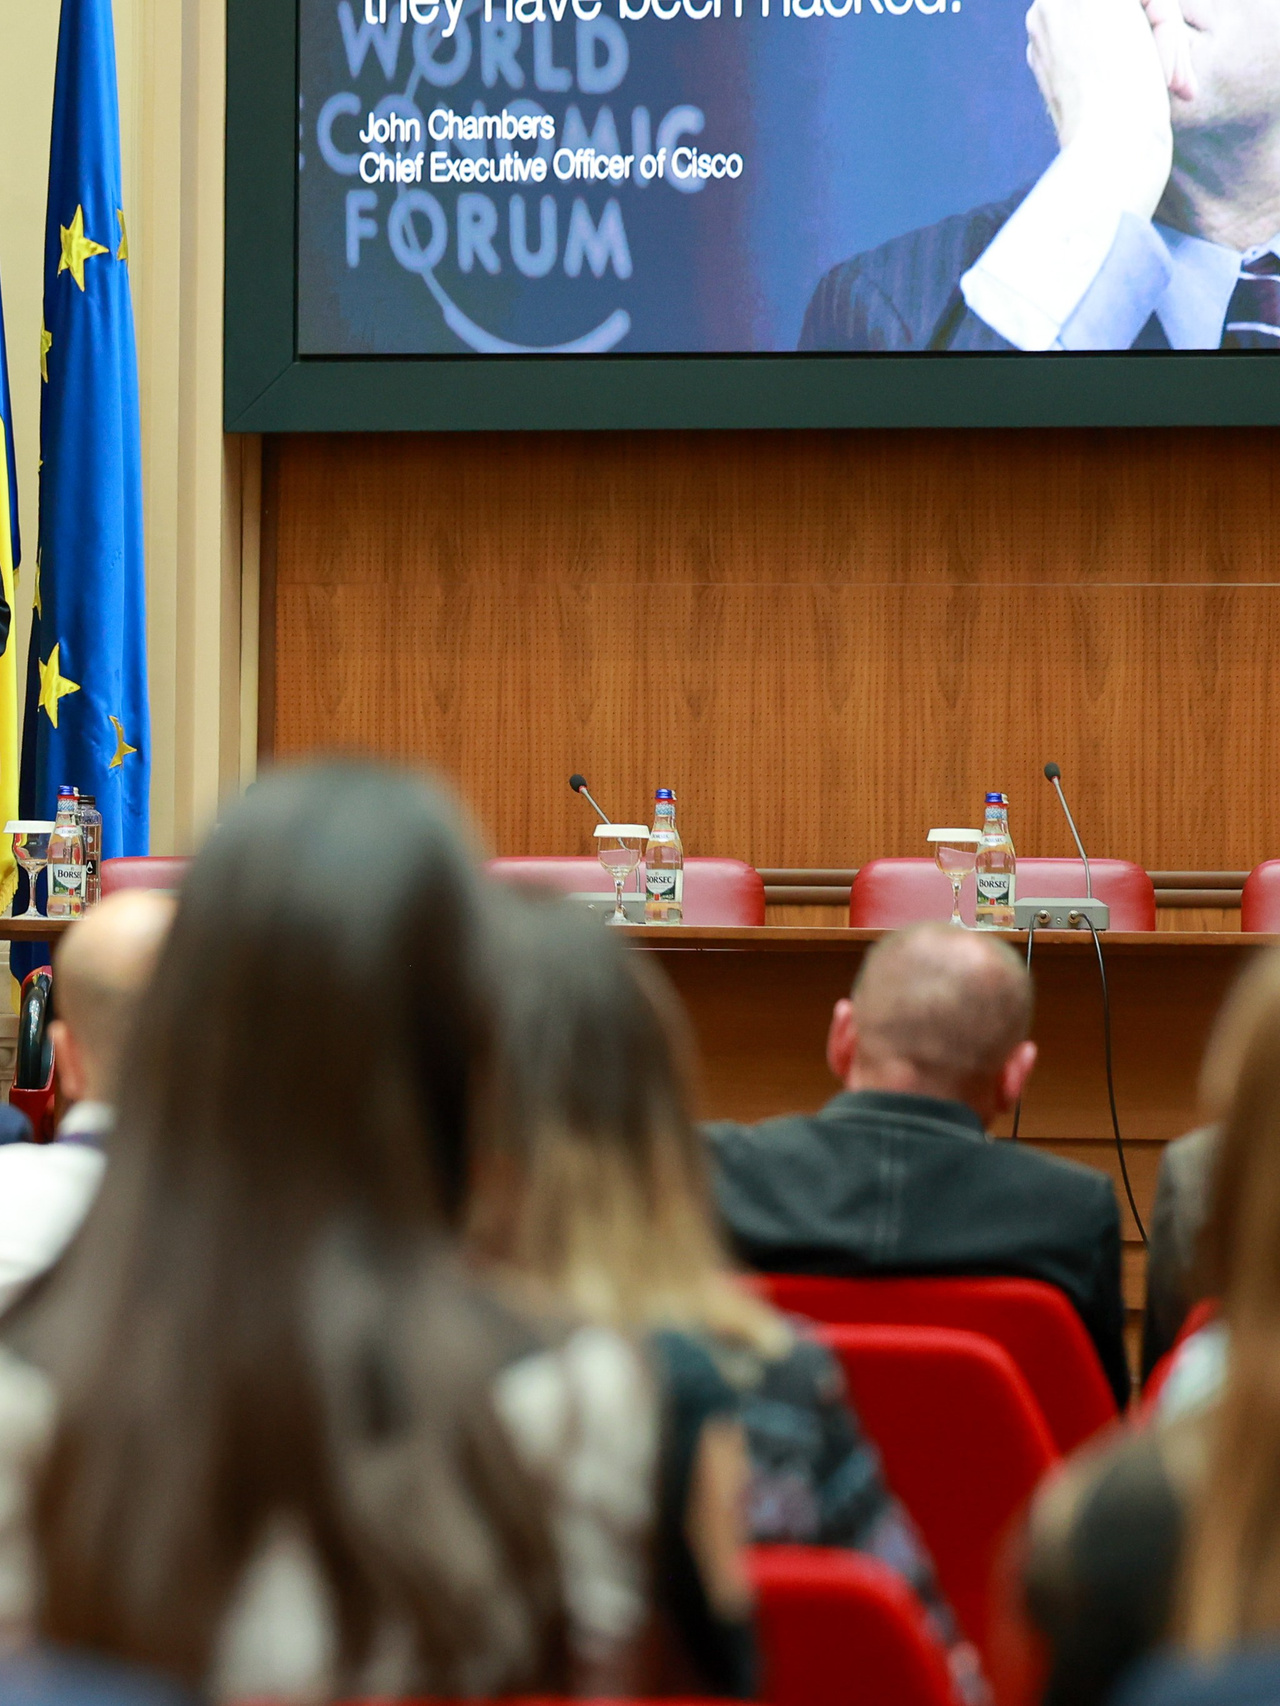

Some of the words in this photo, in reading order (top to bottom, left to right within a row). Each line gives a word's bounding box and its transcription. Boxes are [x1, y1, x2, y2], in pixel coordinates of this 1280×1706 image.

[337, 0, 630, 94] WORLD
[299, 92, 706, 193] CONOMIC
[359, 112, 420, 143] John
[428, 109, 556, 141] Chambers
[359, 151, 424, 183] Chief
[430, 150, 547, 183] Executive
[553, 147, 634, 180] Officer
[640, 147, 667, 179] of
[671, 146, 744, 179] Cisco
[345, 188, 634, 280] FORUM
[979, 878, 1007, 888] BORSEC
